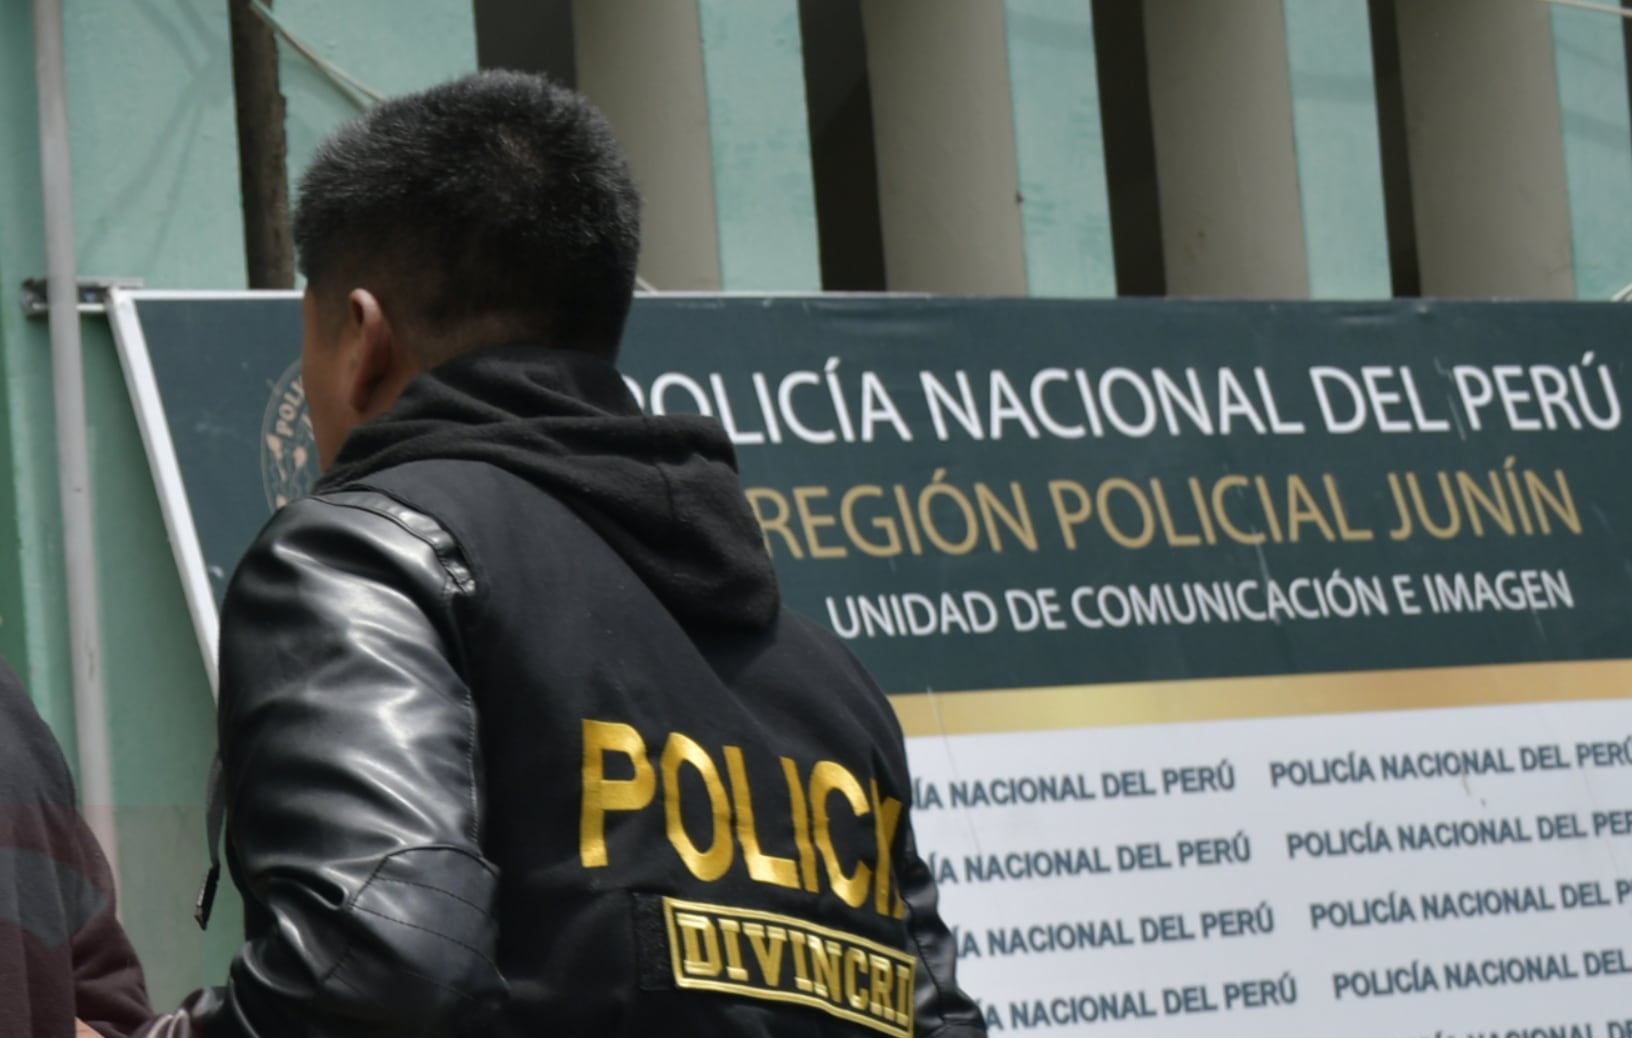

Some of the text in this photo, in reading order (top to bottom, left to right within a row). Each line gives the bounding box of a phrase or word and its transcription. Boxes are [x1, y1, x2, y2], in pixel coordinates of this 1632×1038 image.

[919, 366, 1305, 441] NACIONAL
[1309, 365, 1451, 434] DEL
[1454, 351, 1622, 431] PERÚ
[744, 455, 1583, 560] REGIÓN POLICIAL JUNÍN
[826, 569, 1575, 639] UNIDAD DE COMUNICACIÓN E IMAGEN
[950, 774, 1095, 808] NACIONAL
[1102, 770, 1156, 799] DEL
[1163, 760, 1235, 793] PERÚ
[1269, 751, 1375, 787] POLICÍA
[1380, 748, 1514, 780] NACIONAL
[1519, 744, 1571, 771] DEL
[965, 847, 1110, 883] NACIONAL
[1116, 843, 1171, 871] DEL
[1177, 831, 1251, 867] PERÚ
[1287, 809, 1632, 858] POLICÍA NACIONAL DEL PE
[987, 920, 1134, 956] NACIONAL
[1139, 914, 1194, 943] DEL
[1200, 901, 1274, 938] PERÚ
[1309, 891, 1416, 929] POLICÍA
[1421, 886, 1555, 921] NACIONAL
[1559, 882, 1611, 909] DEL
[676, 912, 911, 1027] DIVINCRI
[1333, 948, 1632, 998] POLICÍA NACIONAL DEL
[1010, 991, 1156, 1029] NACIONAL
[1163, 986, 1217, 1014] DEL
[1223, 972, 1297, 1008] PERÚ
